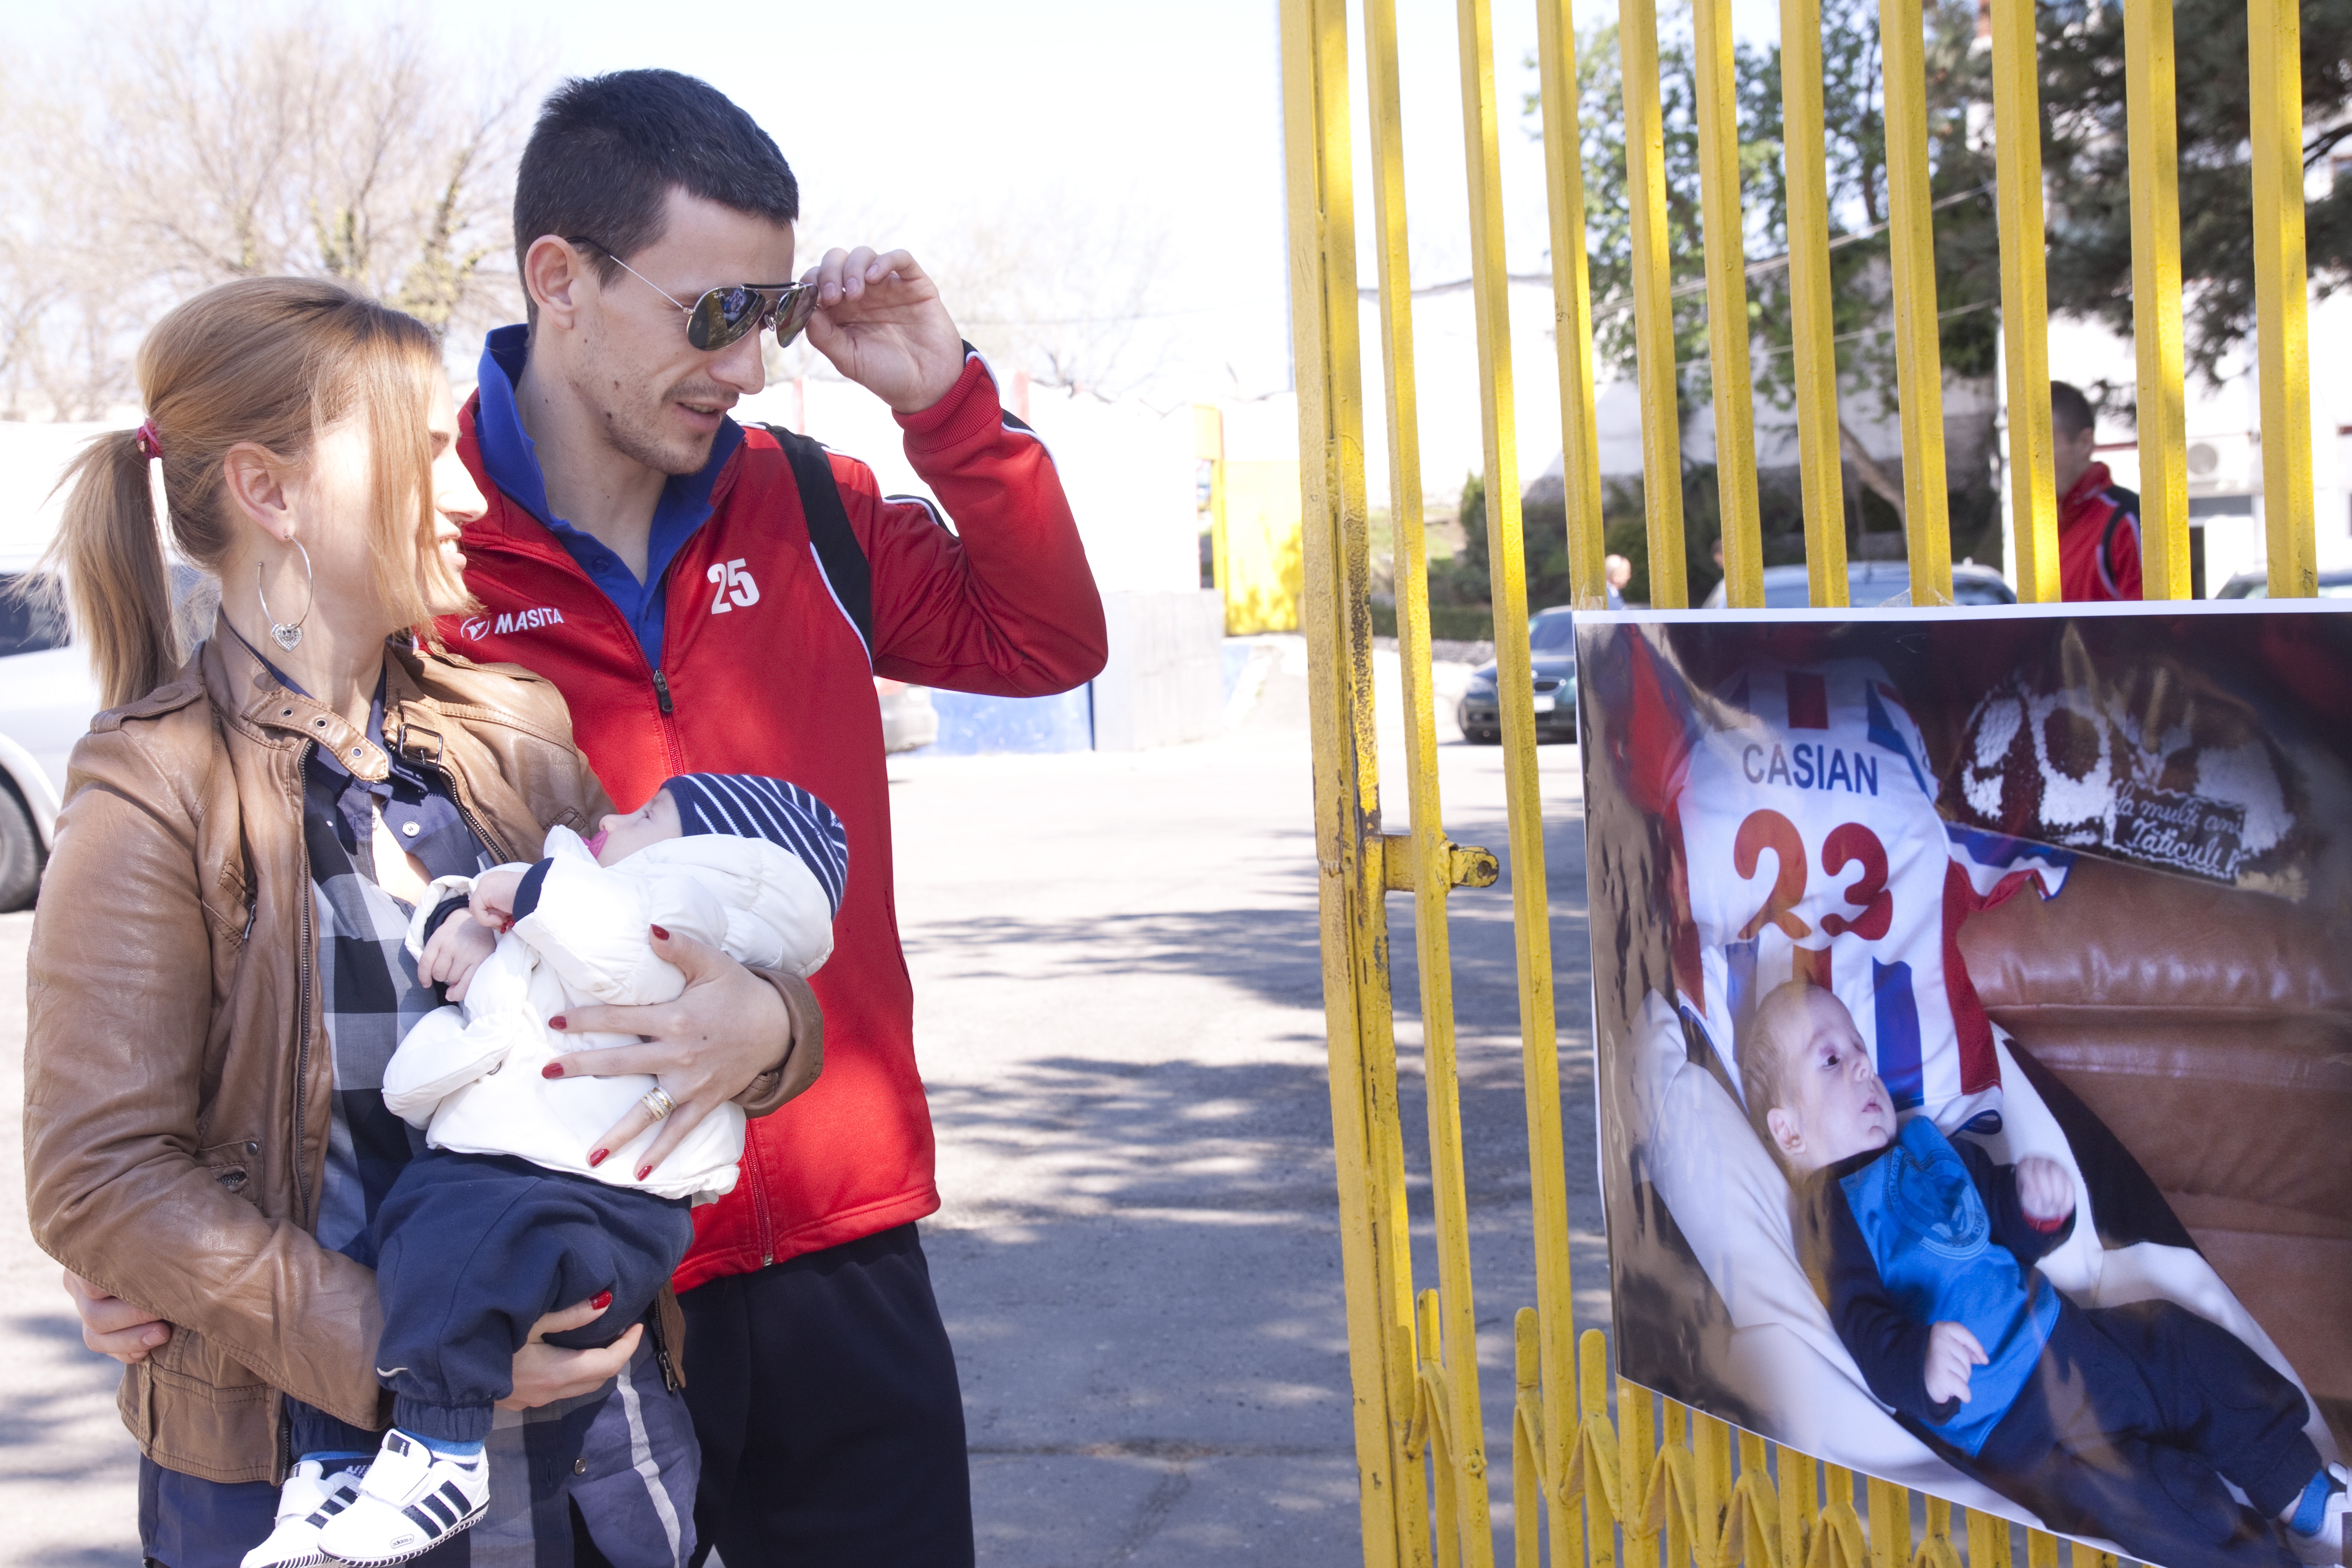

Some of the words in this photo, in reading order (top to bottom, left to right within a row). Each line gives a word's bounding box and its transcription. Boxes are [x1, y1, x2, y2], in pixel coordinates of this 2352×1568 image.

[707, 558, 760, 614] 25
[494, 607, 565, 634] MASITA
[1742, 743, 1878, 796] CASIAN
[1734, 808, 1893, 941] 23
